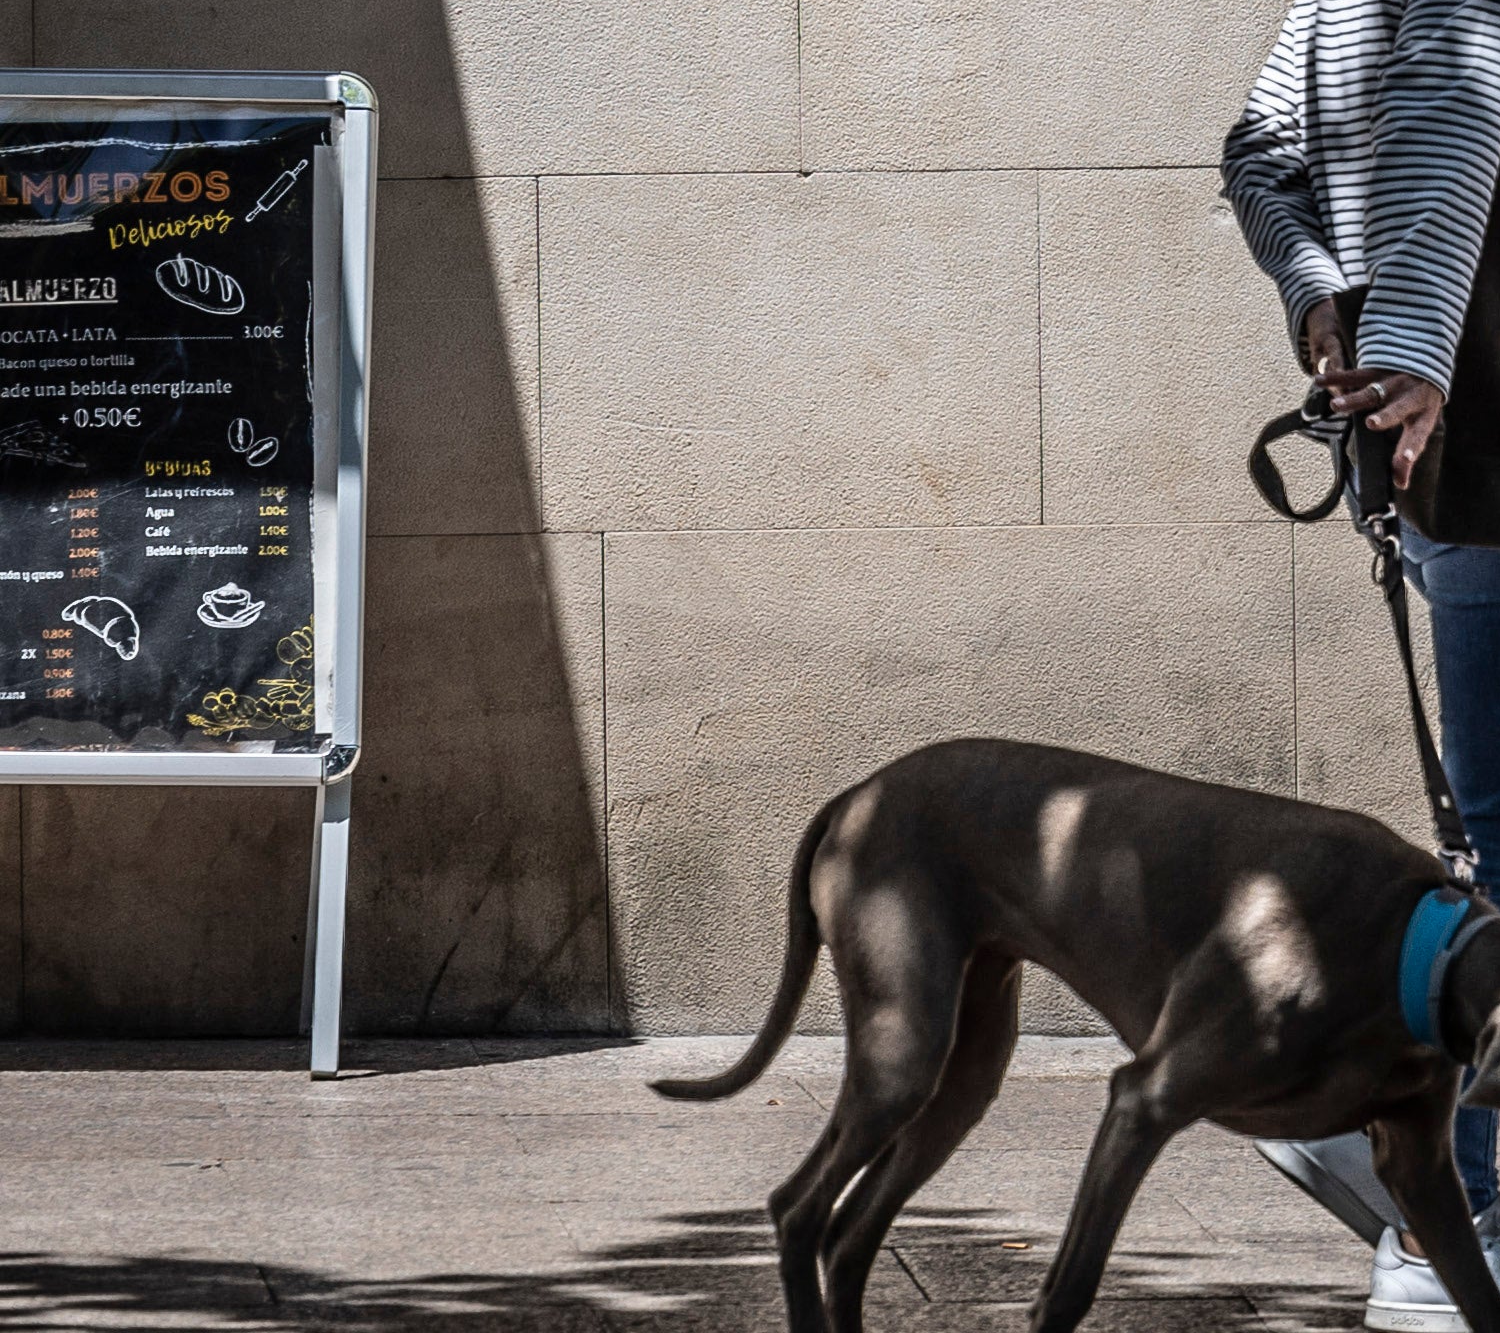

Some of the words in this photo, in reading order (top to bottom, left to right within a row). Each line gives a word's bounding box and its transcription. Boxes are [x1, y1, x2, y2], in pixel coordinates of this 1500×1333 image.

[109, 209, 234, 249] Deliciosos
[72, 328, 118, 341] LATA
[34, 384, 66, 397] una
[70, 381, 126, 396] bebida
[74, 407, 142, 427] 0.50€
[145, 507, 174, 518] Agua
[145, 526, 171, 537] Café
